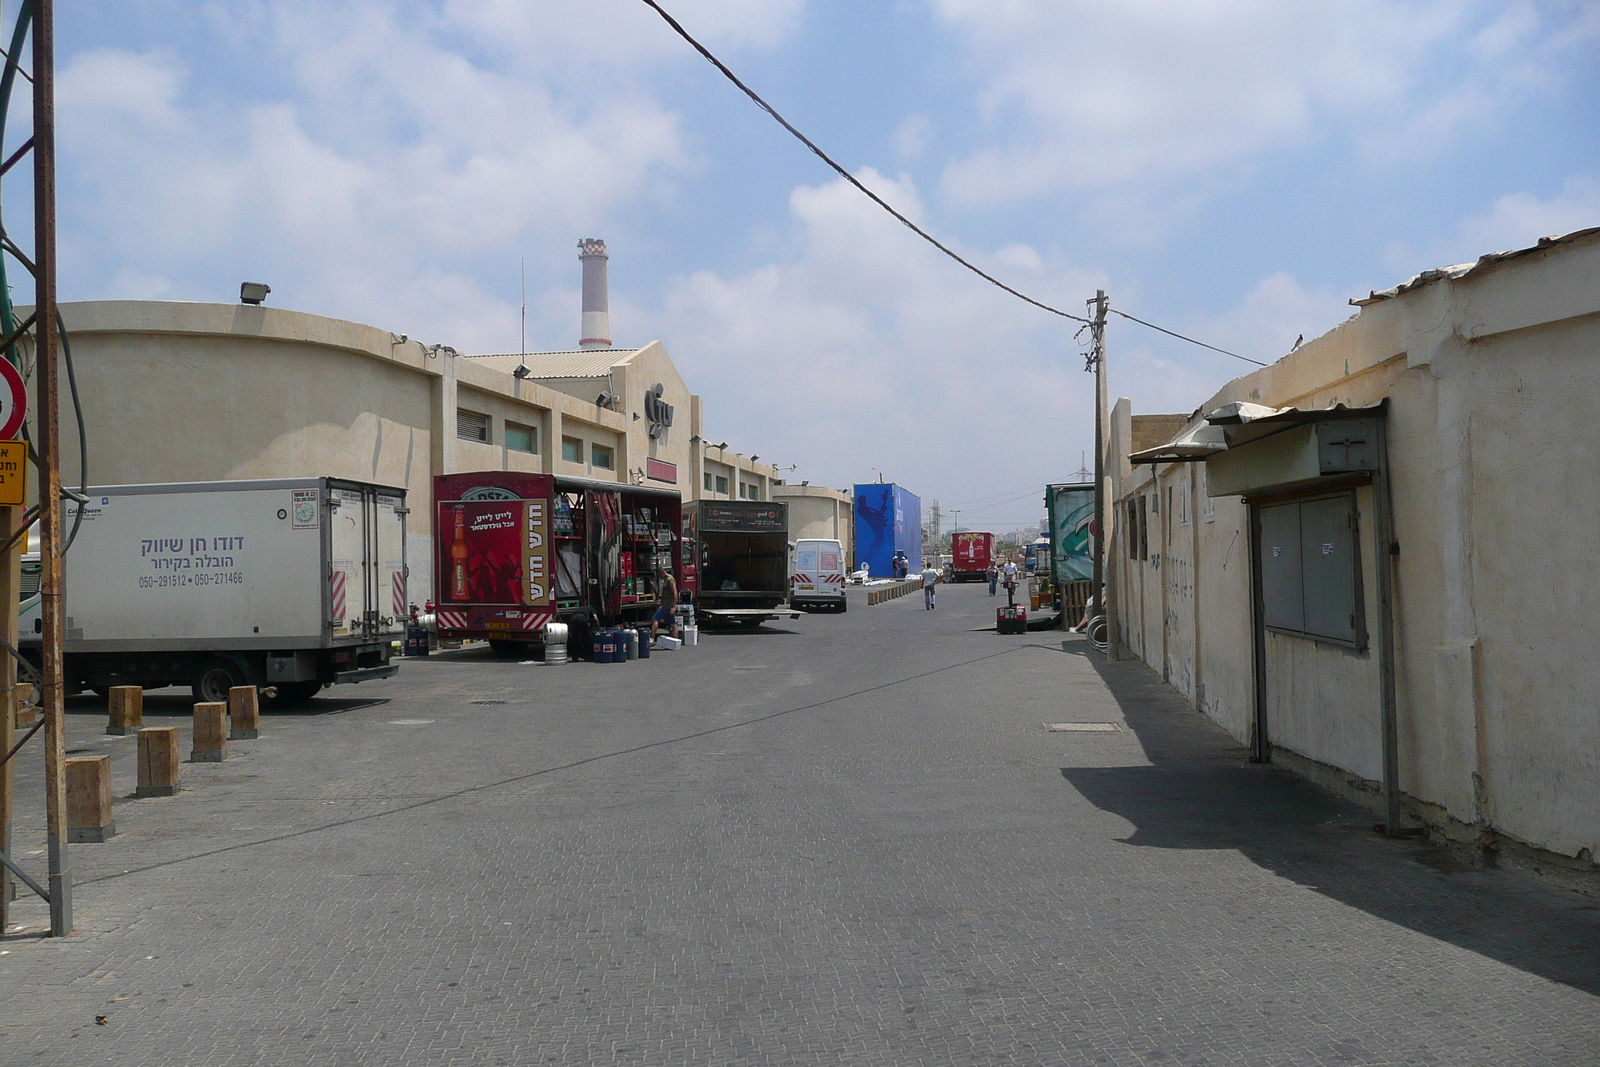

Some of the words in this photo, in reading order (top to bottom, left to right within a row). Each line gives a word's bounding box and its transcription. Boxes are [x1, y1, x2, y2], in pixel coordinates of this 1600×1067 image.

[495, 511, 512, 521] לייט
[502, 521, 515, 529] אבל
[529, 504, 543, 549] חדש
[141, 538, 184, 557] שיווק
[190, 537, 207, 556] חן
[213, 537, 244, 551] דודו
[150, 557, 191, 572] בקירור
[195, 554, 234, 568] הובלה
[139, 575, 187, 589] 050-291512
[194, 572, 243, 586] 050-271466
[529, 556, 545, 601] חדש
